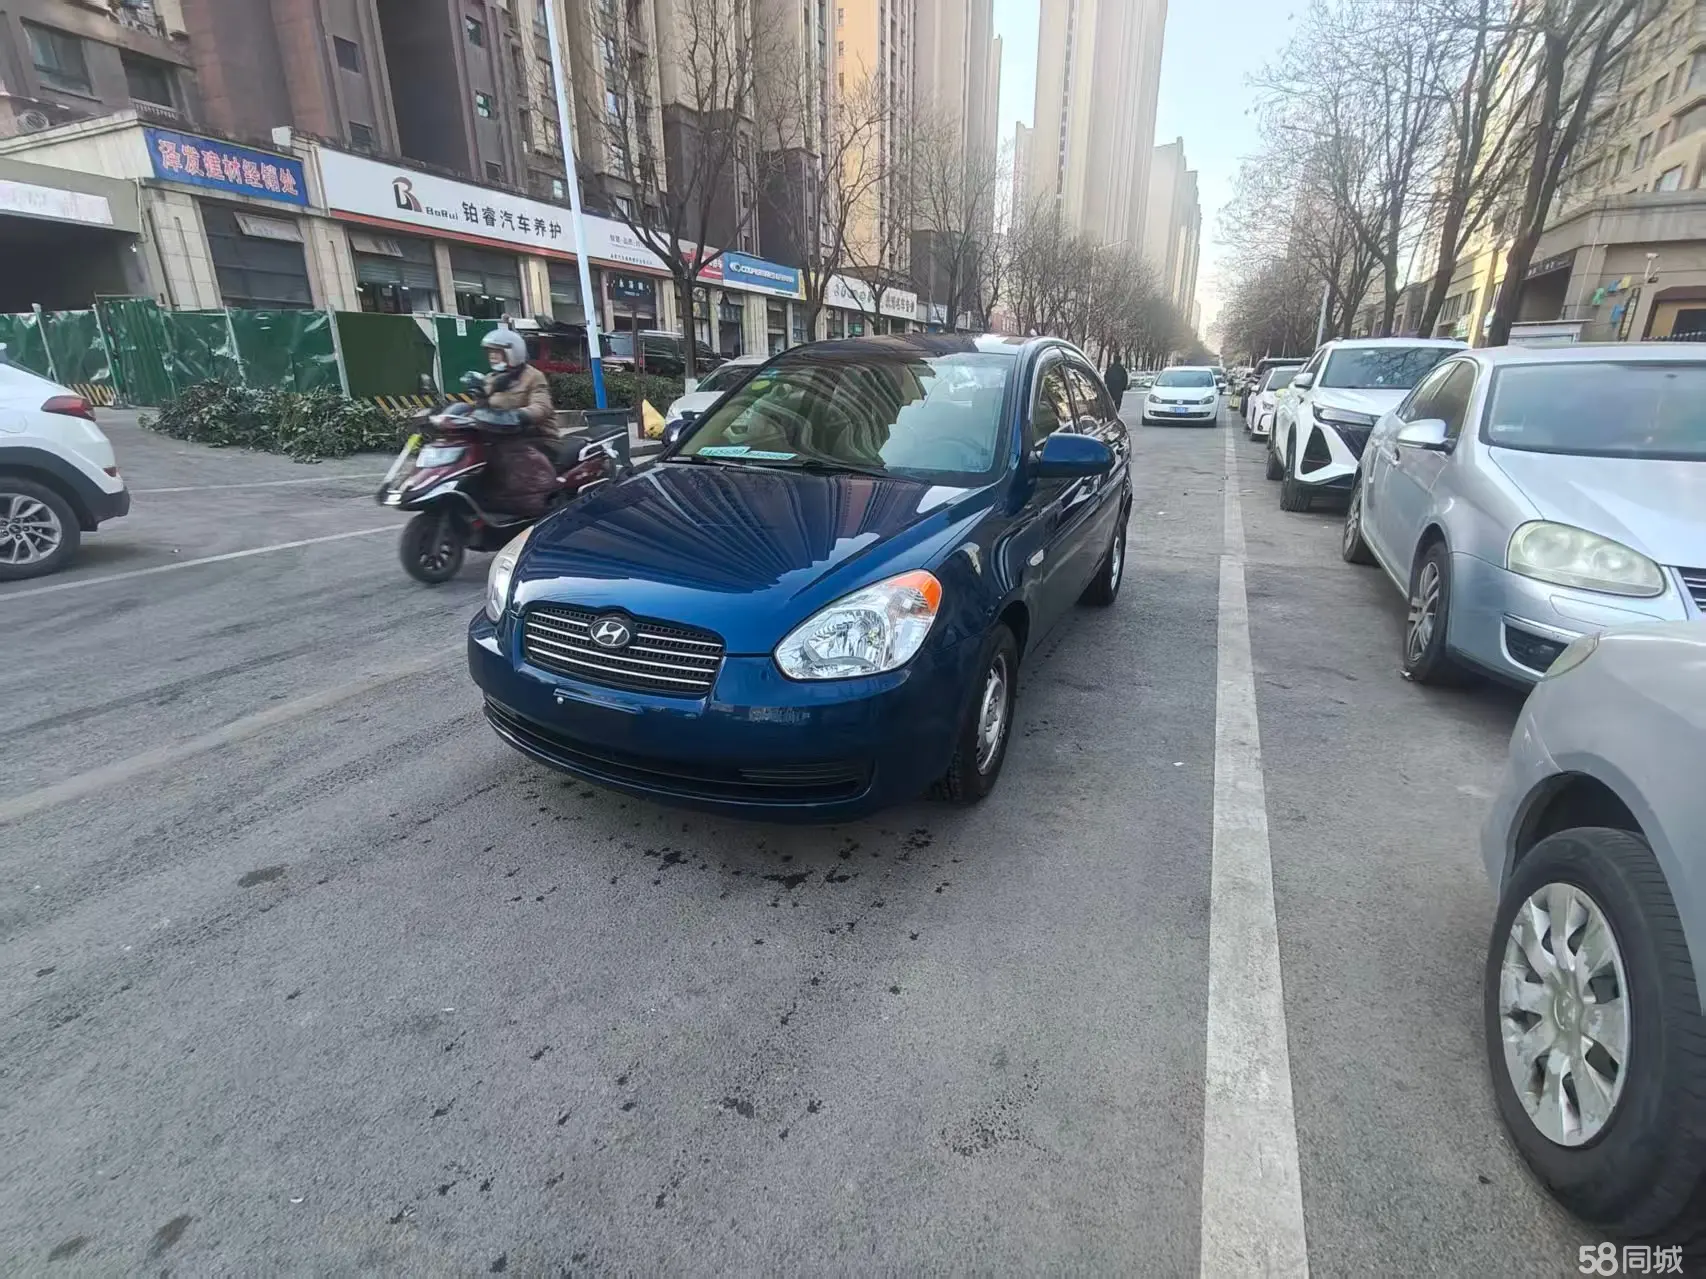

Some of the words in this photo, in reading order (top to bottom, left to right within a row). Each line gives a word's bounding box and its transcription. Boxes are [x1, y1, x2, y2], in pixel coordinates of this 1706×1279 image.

[462, 200, 562, 239] 铂睿汽车养护
